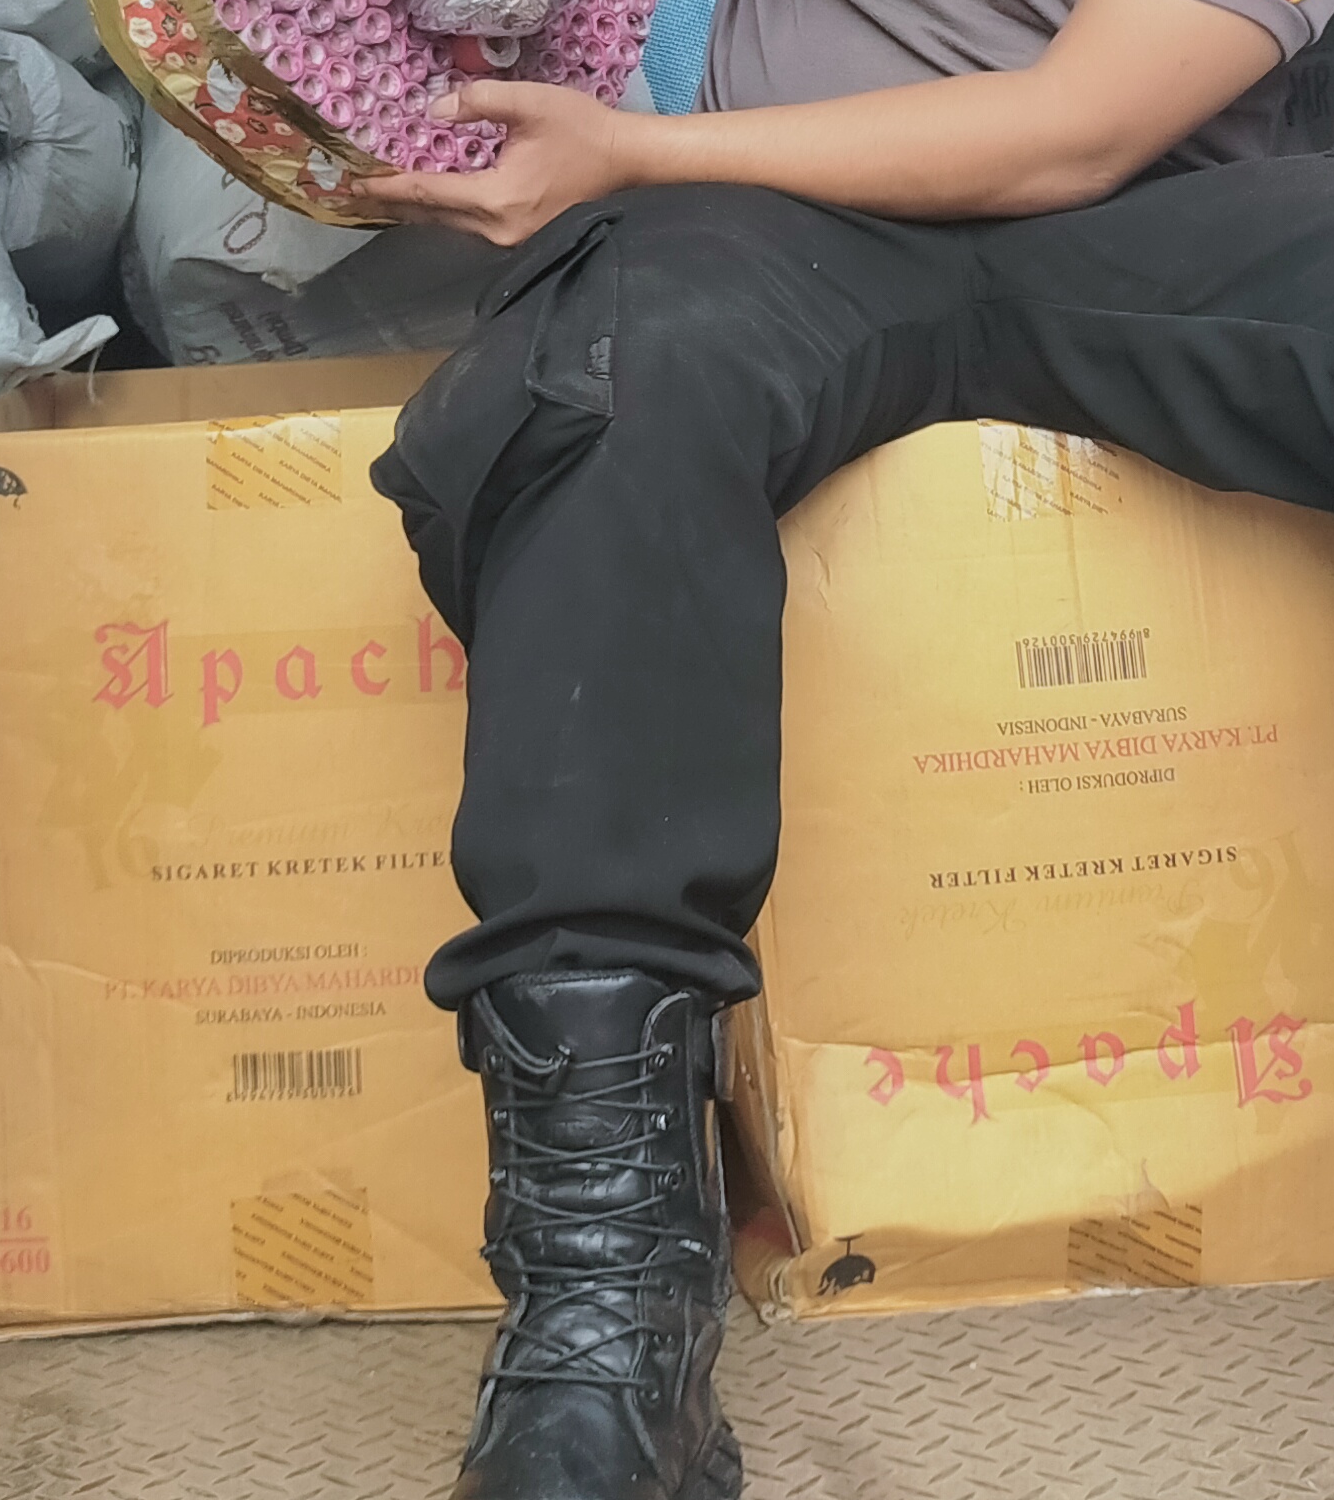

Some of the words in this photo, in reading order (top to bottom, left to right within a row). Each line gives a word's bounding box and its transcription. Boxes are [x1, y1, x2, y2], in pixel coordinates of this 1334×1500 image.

[92, 612, 468, 730] Apach
[996, 715, 1088, 737] INDONESIA
[1099, 705, 1188, 728] SURABAYA
[1085, 734, 1159, 759] DIBYA
[1165, 726, 1242, 753] KARYA
[1247, 722, 1280, 746] PT.
[912, 742, 1080, 775] MAHARDHIKA
[1027, 777, 1073, 794] OLEH
[1076, 767, 1176, 790] DIPRODUKSI
[151, 860, 261, 883] SIGARET
[266, 855, 367, 878] KRETEK
[374, 849, 454, 872] FILTE
[1025, 857, 1125, 882] KRETEK
[1130, 845, 1239, 873] SIGARET
[928, 865, 1018, 890] FILTER
[209, 945, 312, 966] DIPRODUKSI
[313, 942, 360, 961] OLEH
[142, 976, 222, 1001] KARYA
[226, 972, 305, 998] DIBYA
[194, 1007, 284, 1026] SURABAYA
[294, 1001, 388, 1021] INDONESIA
[866, 1000, 1315, 1128] Apache
